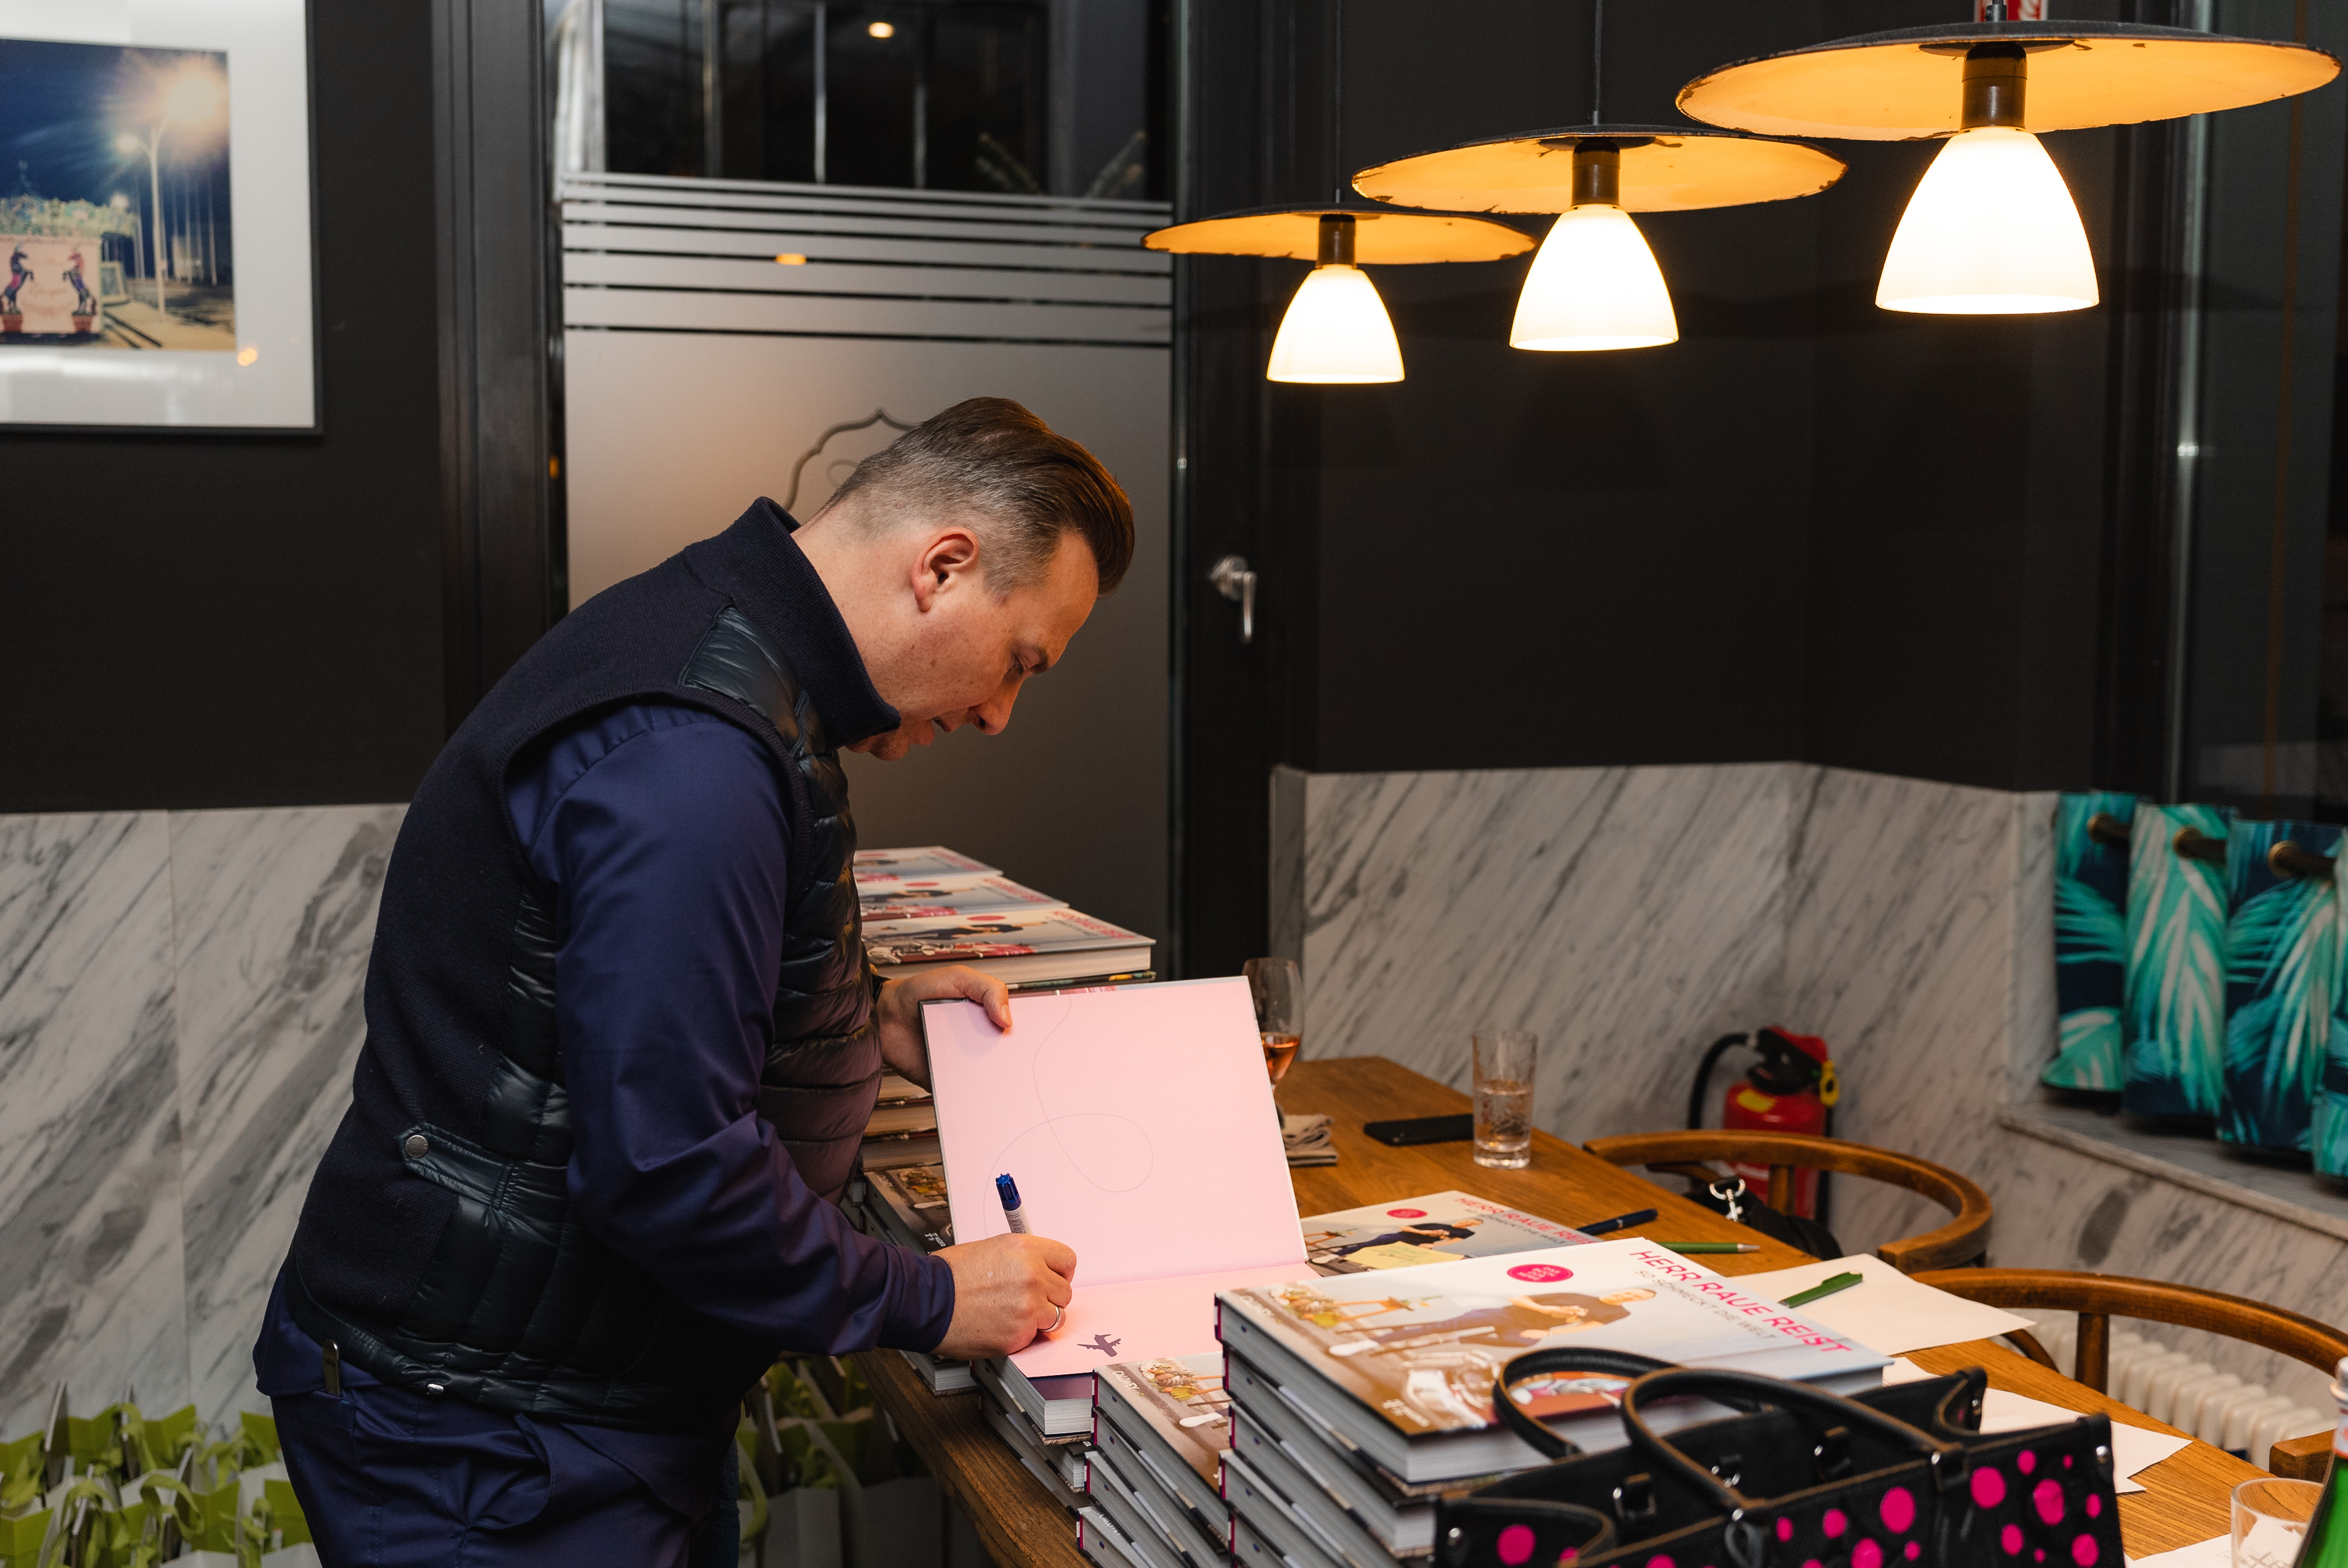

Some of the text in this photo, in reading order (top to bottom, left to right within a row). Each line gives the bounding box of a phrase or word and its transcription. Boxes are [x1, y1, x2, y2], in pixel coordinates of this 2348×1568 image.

[1503, 1213, 1557, 1231] RAUE
[1553, 1231, 1598, 1245] REI
[1629, 1251, 1853, 1352] HERR RAUE REIST
[1635, 1270, 1777, 1340] SO SCHMECKT DIE WELT
